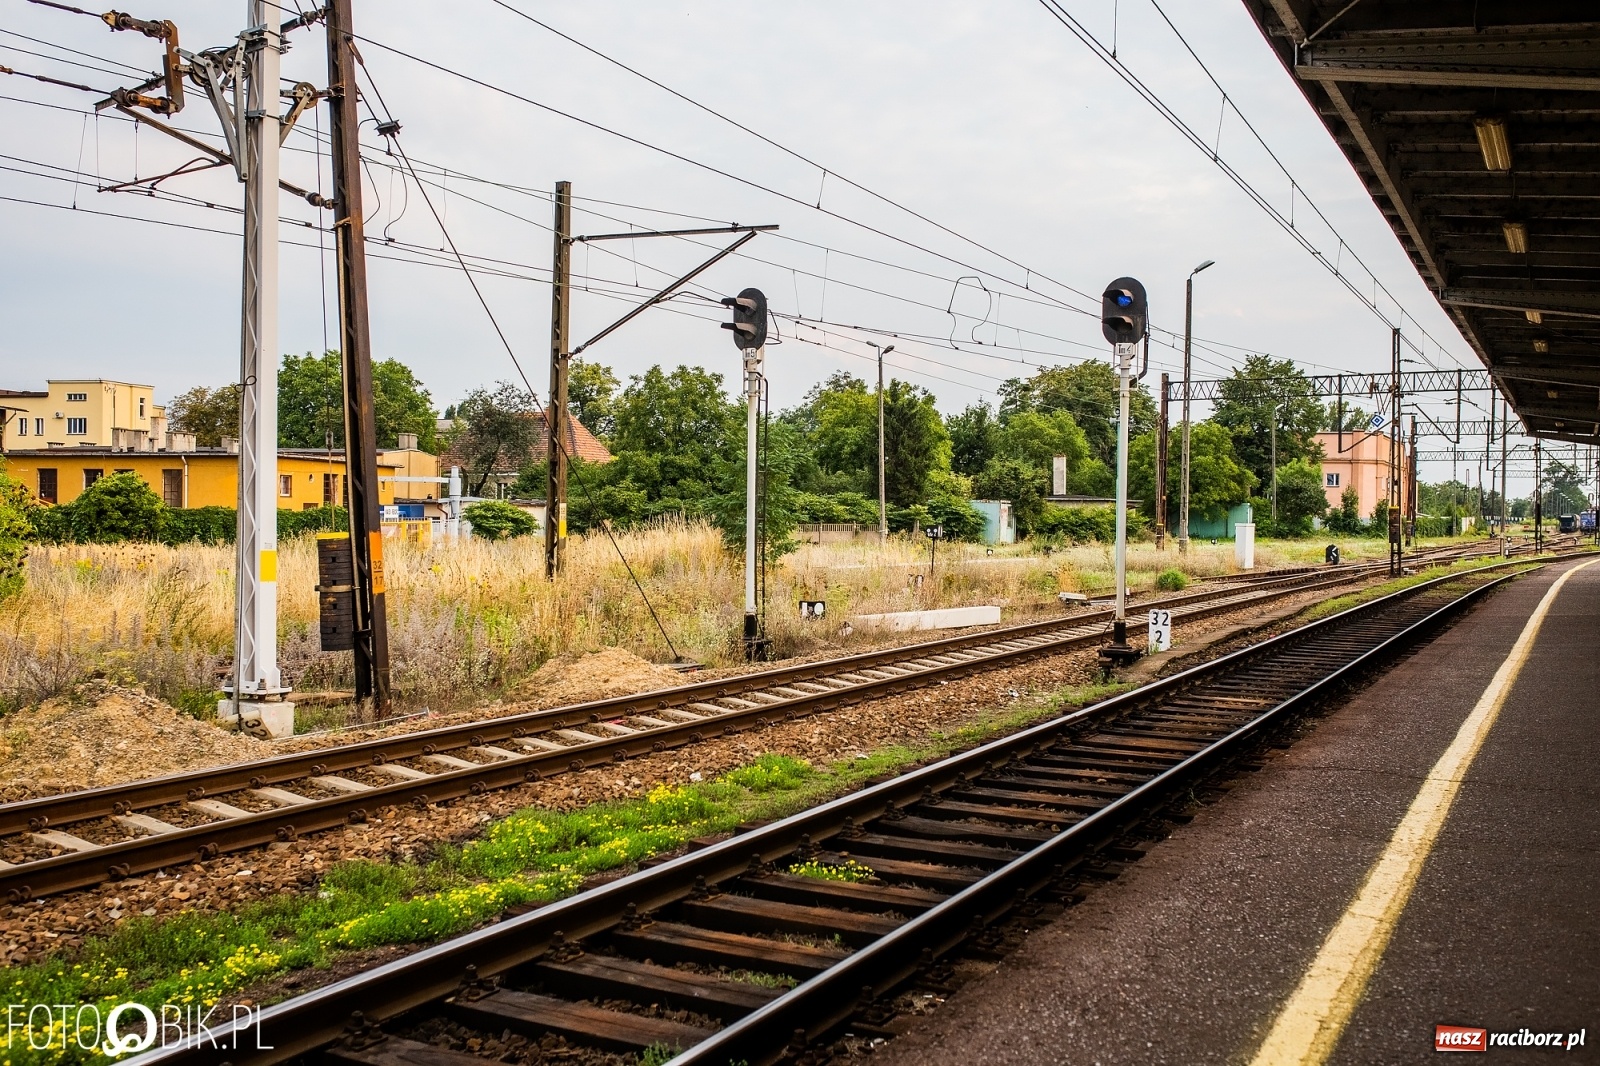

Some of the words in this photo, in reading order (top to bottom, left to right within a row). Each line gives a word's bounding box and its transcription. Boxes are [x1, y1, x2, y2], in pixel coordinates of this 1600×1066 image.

[373, 560, 383, 570] 32
[374, 576, 384, 586] 17
[1151, 611, 1169, 626] 32
[1155, 630, 1163, 644] 2
